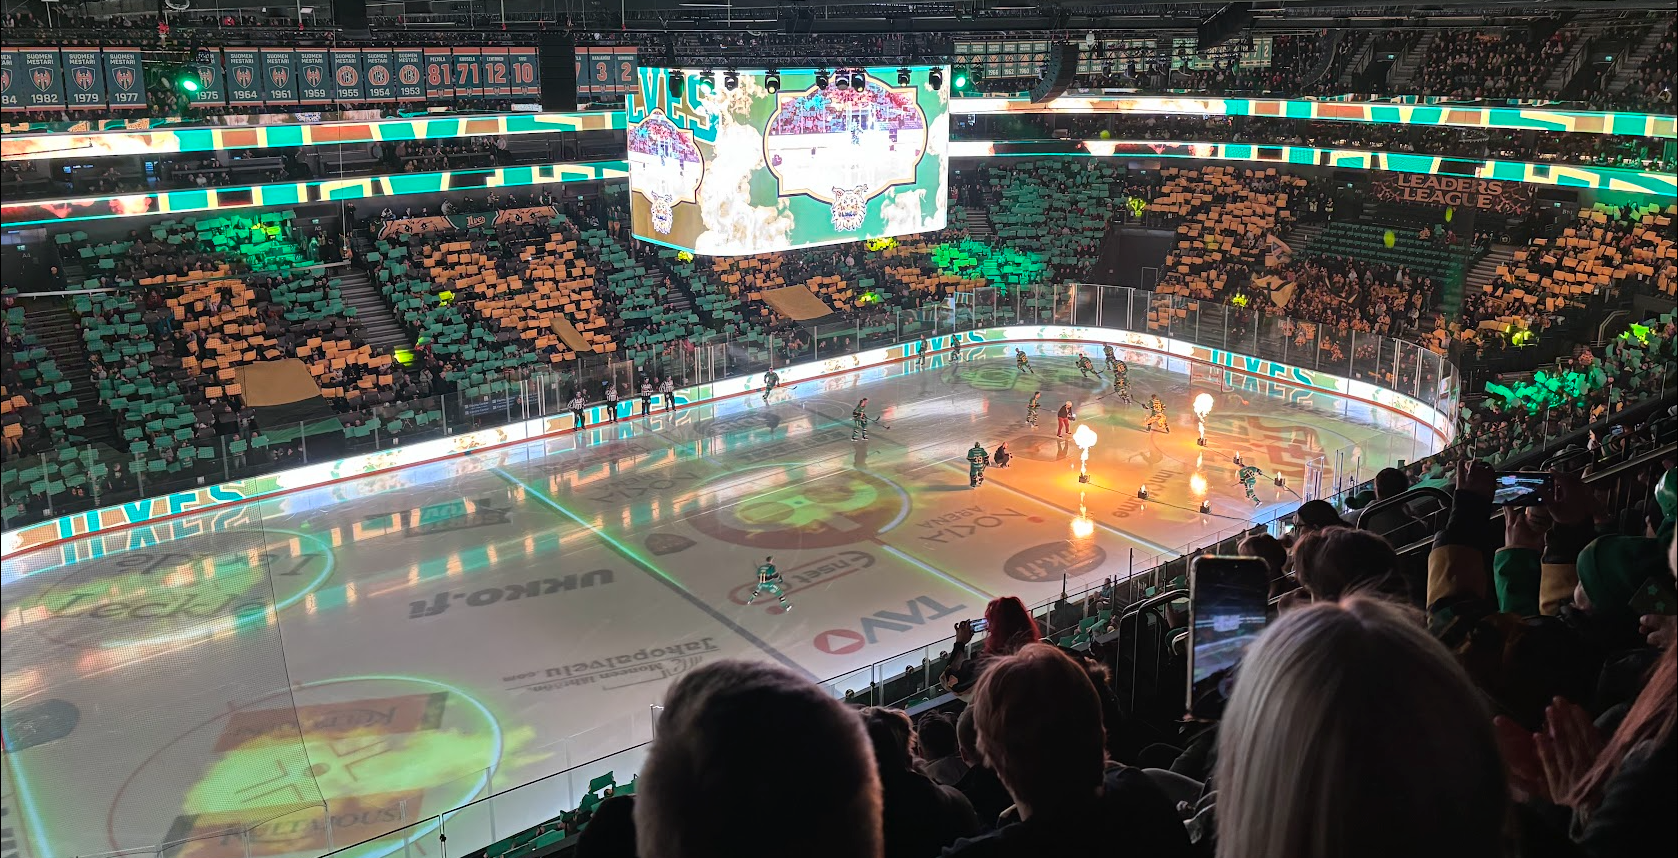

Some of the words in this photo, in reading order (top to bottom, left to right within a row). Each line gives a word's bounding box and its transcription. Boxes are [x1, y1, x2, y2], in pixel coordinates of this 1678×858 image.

[428, 63, 450, 85] 81
[456, 63, 479, 84] 71
[485, 63, 506, 83] 12
[513, 62, 534, 83] 10
[596, 62, 608, 81] 3
[621, 62, 632, 81] 2
[196, 91, 219, 100] 1975
[233, 90, 258, 99] 1964
[270, 90, 292, 99] 1961
[303, 89, 326, 98] 1959
[337, 88, 359, 97] 1955
[369, 88, 390, 97] 1954
[400, 87, 421, 95] 1953
[31, 94, 58, 103] 1982
[73, 93, 99, 103] 1979
[114, 93, 139, 102] 1977
[1398, 173, 1503, 195] LEADERS
[1403, 187, 1494, 209] LEAGUE
[466, 215, 486, 229] Ilves
[914, 504, 985, 530] ARENA
